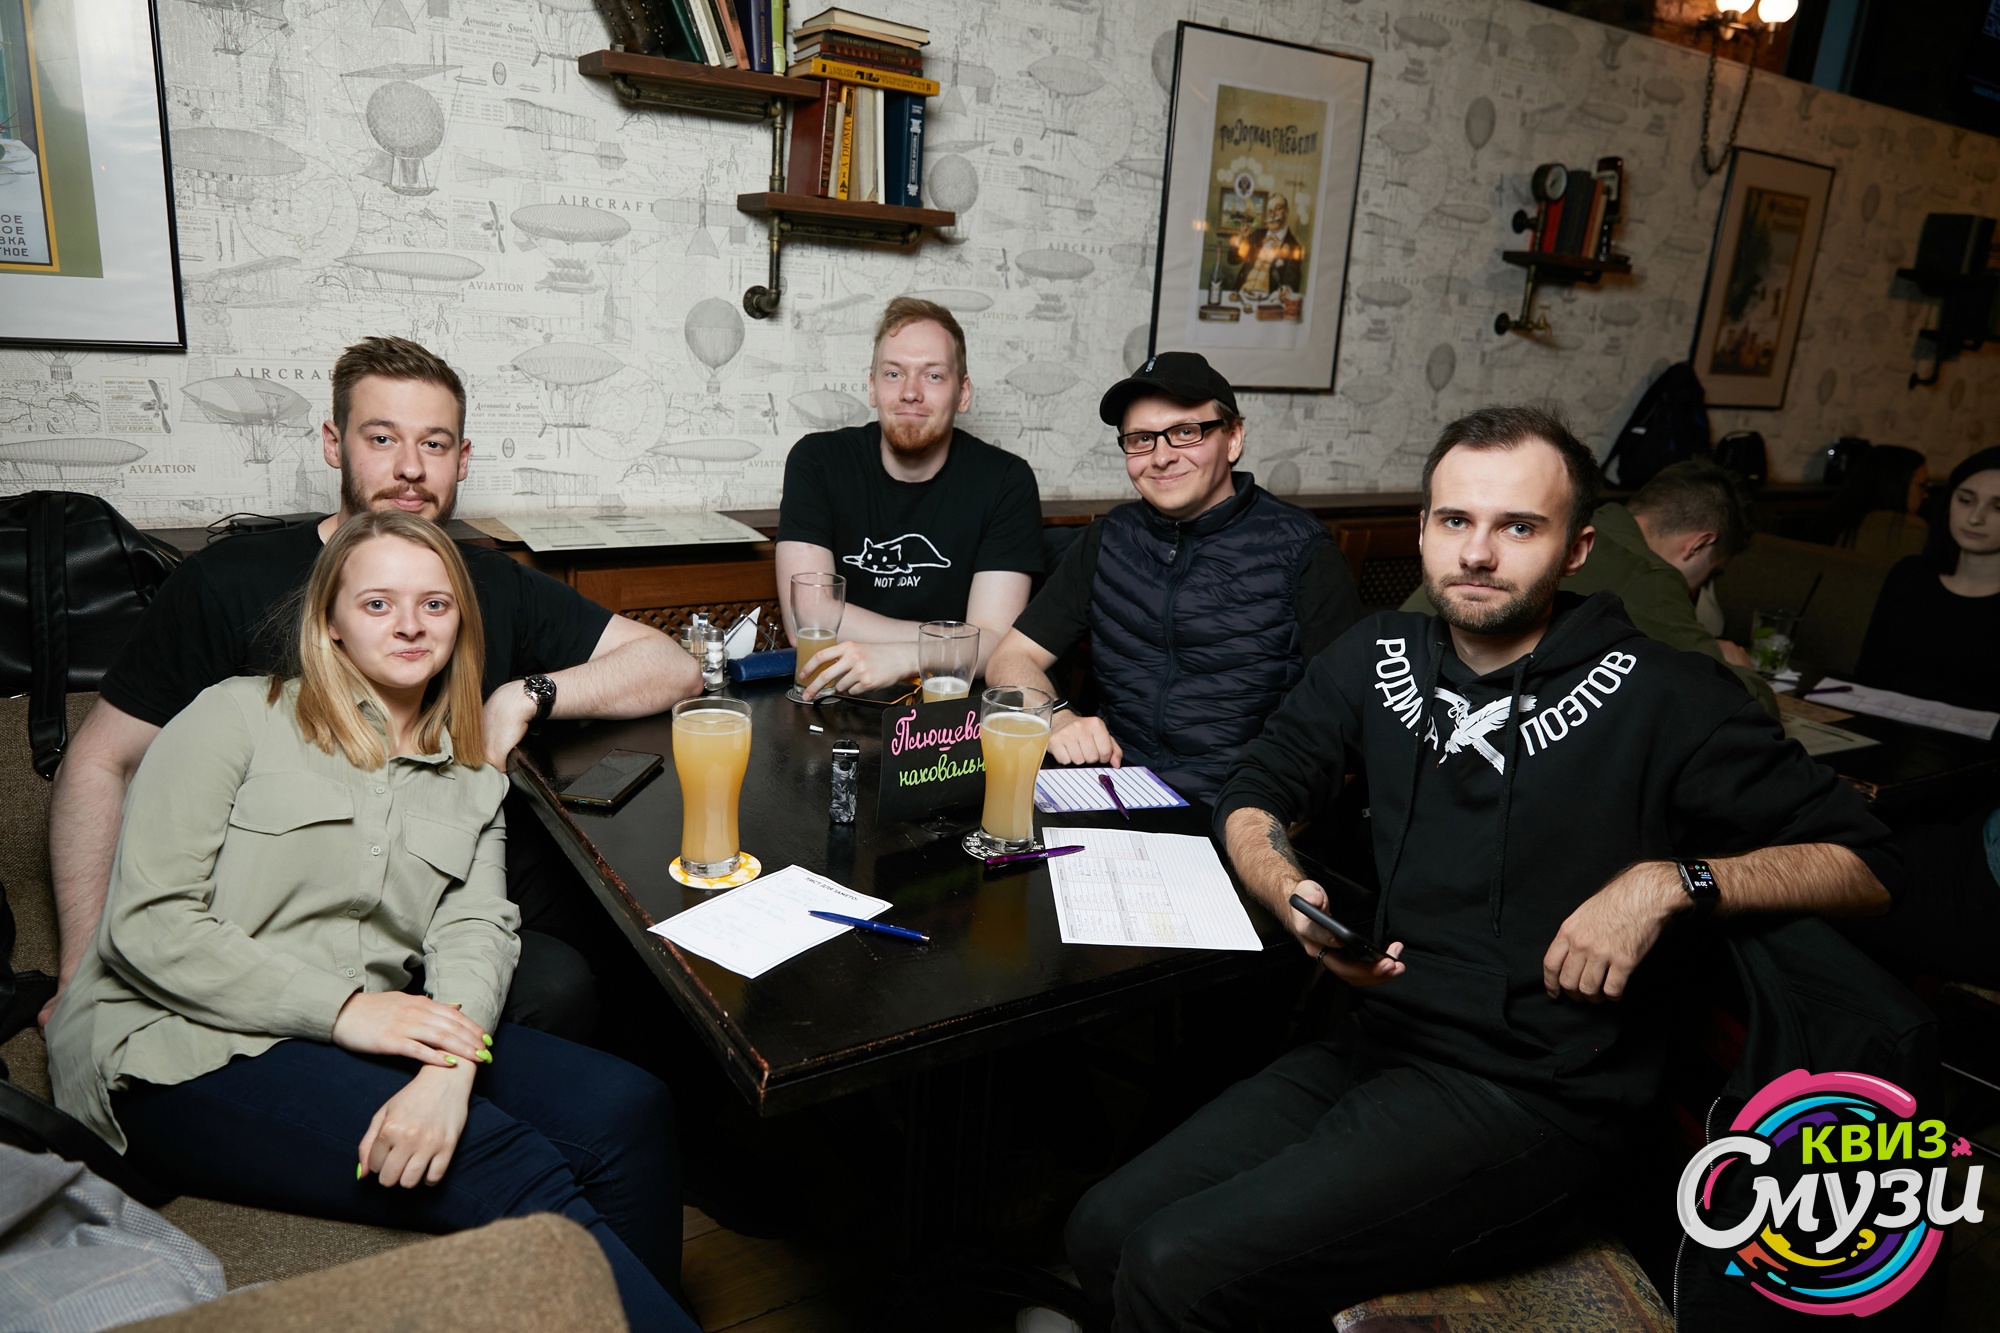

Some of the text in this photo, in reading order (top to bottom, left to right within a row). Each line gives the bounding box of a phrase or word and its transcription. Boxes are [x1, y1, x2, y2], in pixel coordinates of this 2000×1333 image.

[558, 195, 654, 213] AIRCRAFT
[468, 281, 524, 293] AVIATION
[982, 312, 1019, 321] AVIATION
[475, 402, 539, 412] Aeronautical Supplies
[128, 464, 197, 475] AVIATION
[748, 460, 786, 468] AVIATIO
[873, 576, 894, 588] NOT
[1374, 637, 1637, 757] РОДИА ПОЭТОВ
[891, 708, 981, 756] Плюшева
[899, 753, 986, 787] наковальн
